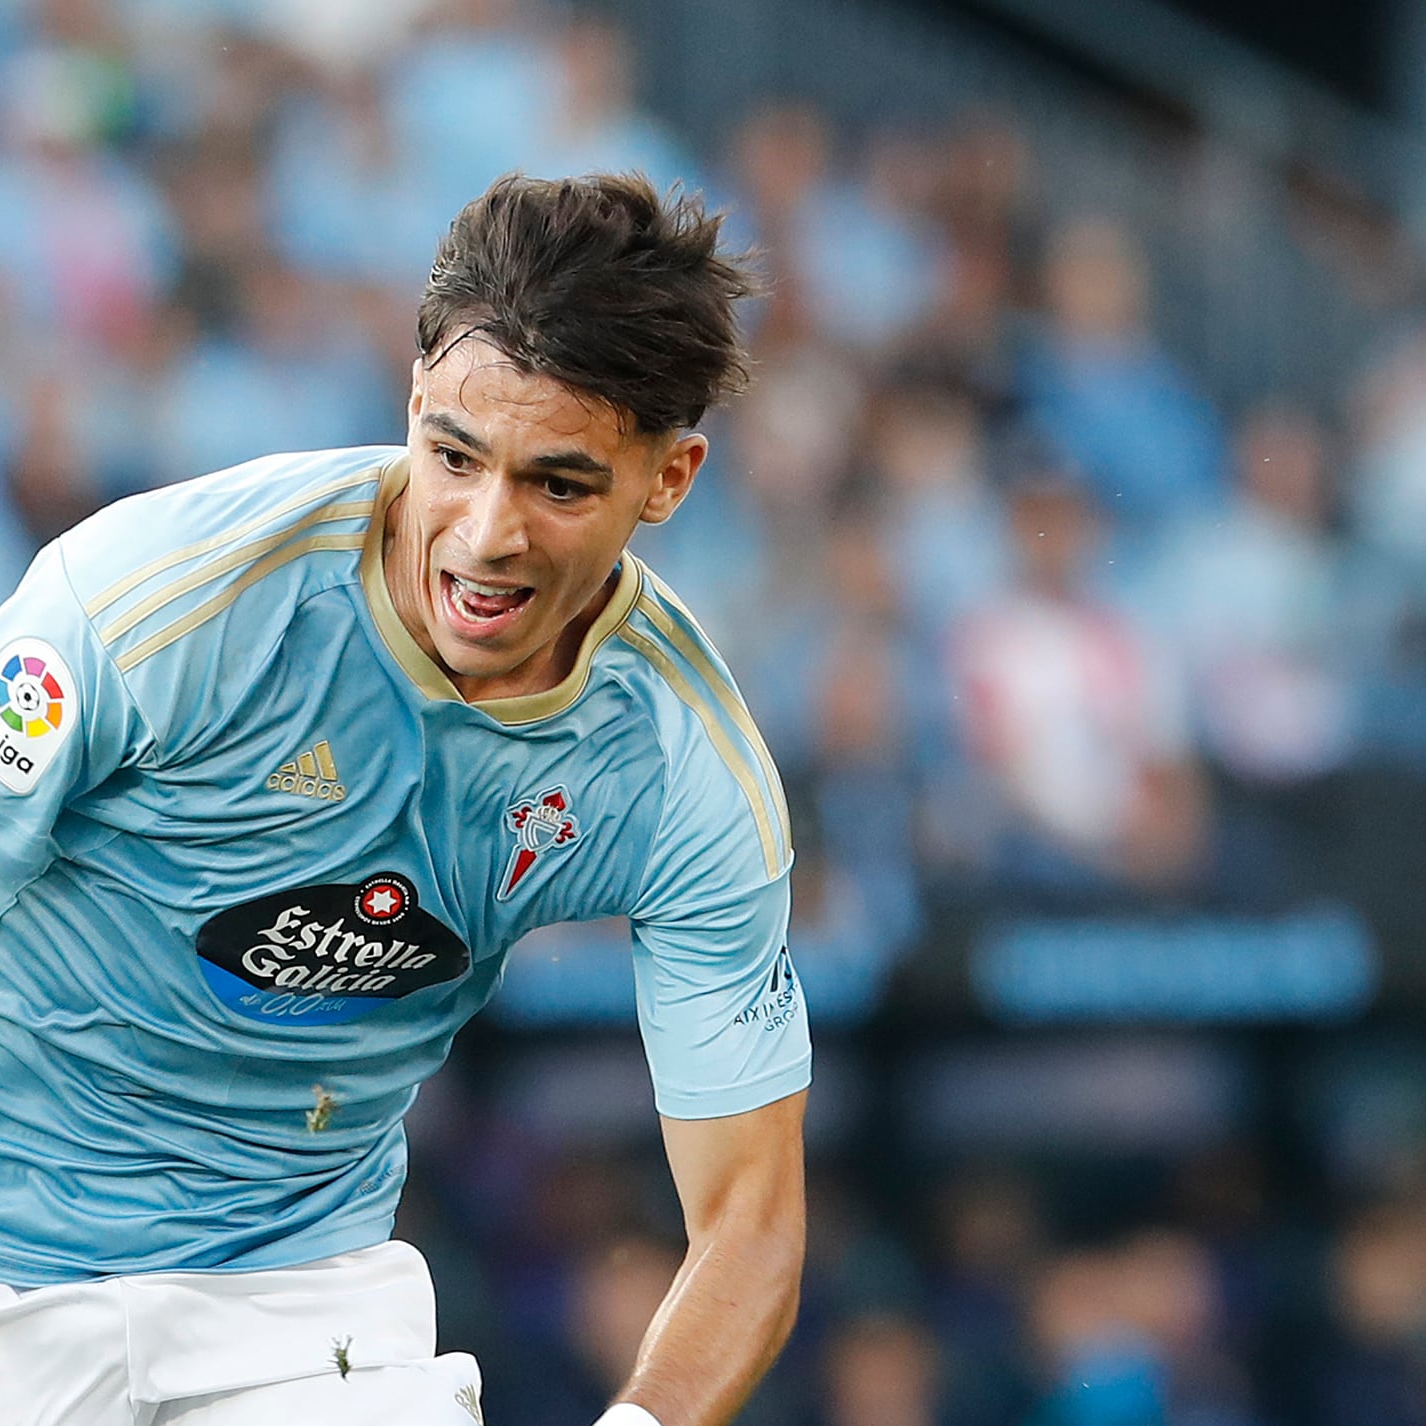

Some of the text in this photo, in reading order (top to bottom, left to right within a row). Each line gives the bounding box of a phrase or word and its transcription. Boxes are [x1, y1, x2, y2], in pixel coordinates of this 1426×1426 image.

[265, 772, 347, 802] adidas
[256, 905, 437, 970] Estrella
[241, 944, 397, 993] Galicia
[734, 1006, 760, 1026] AIX
